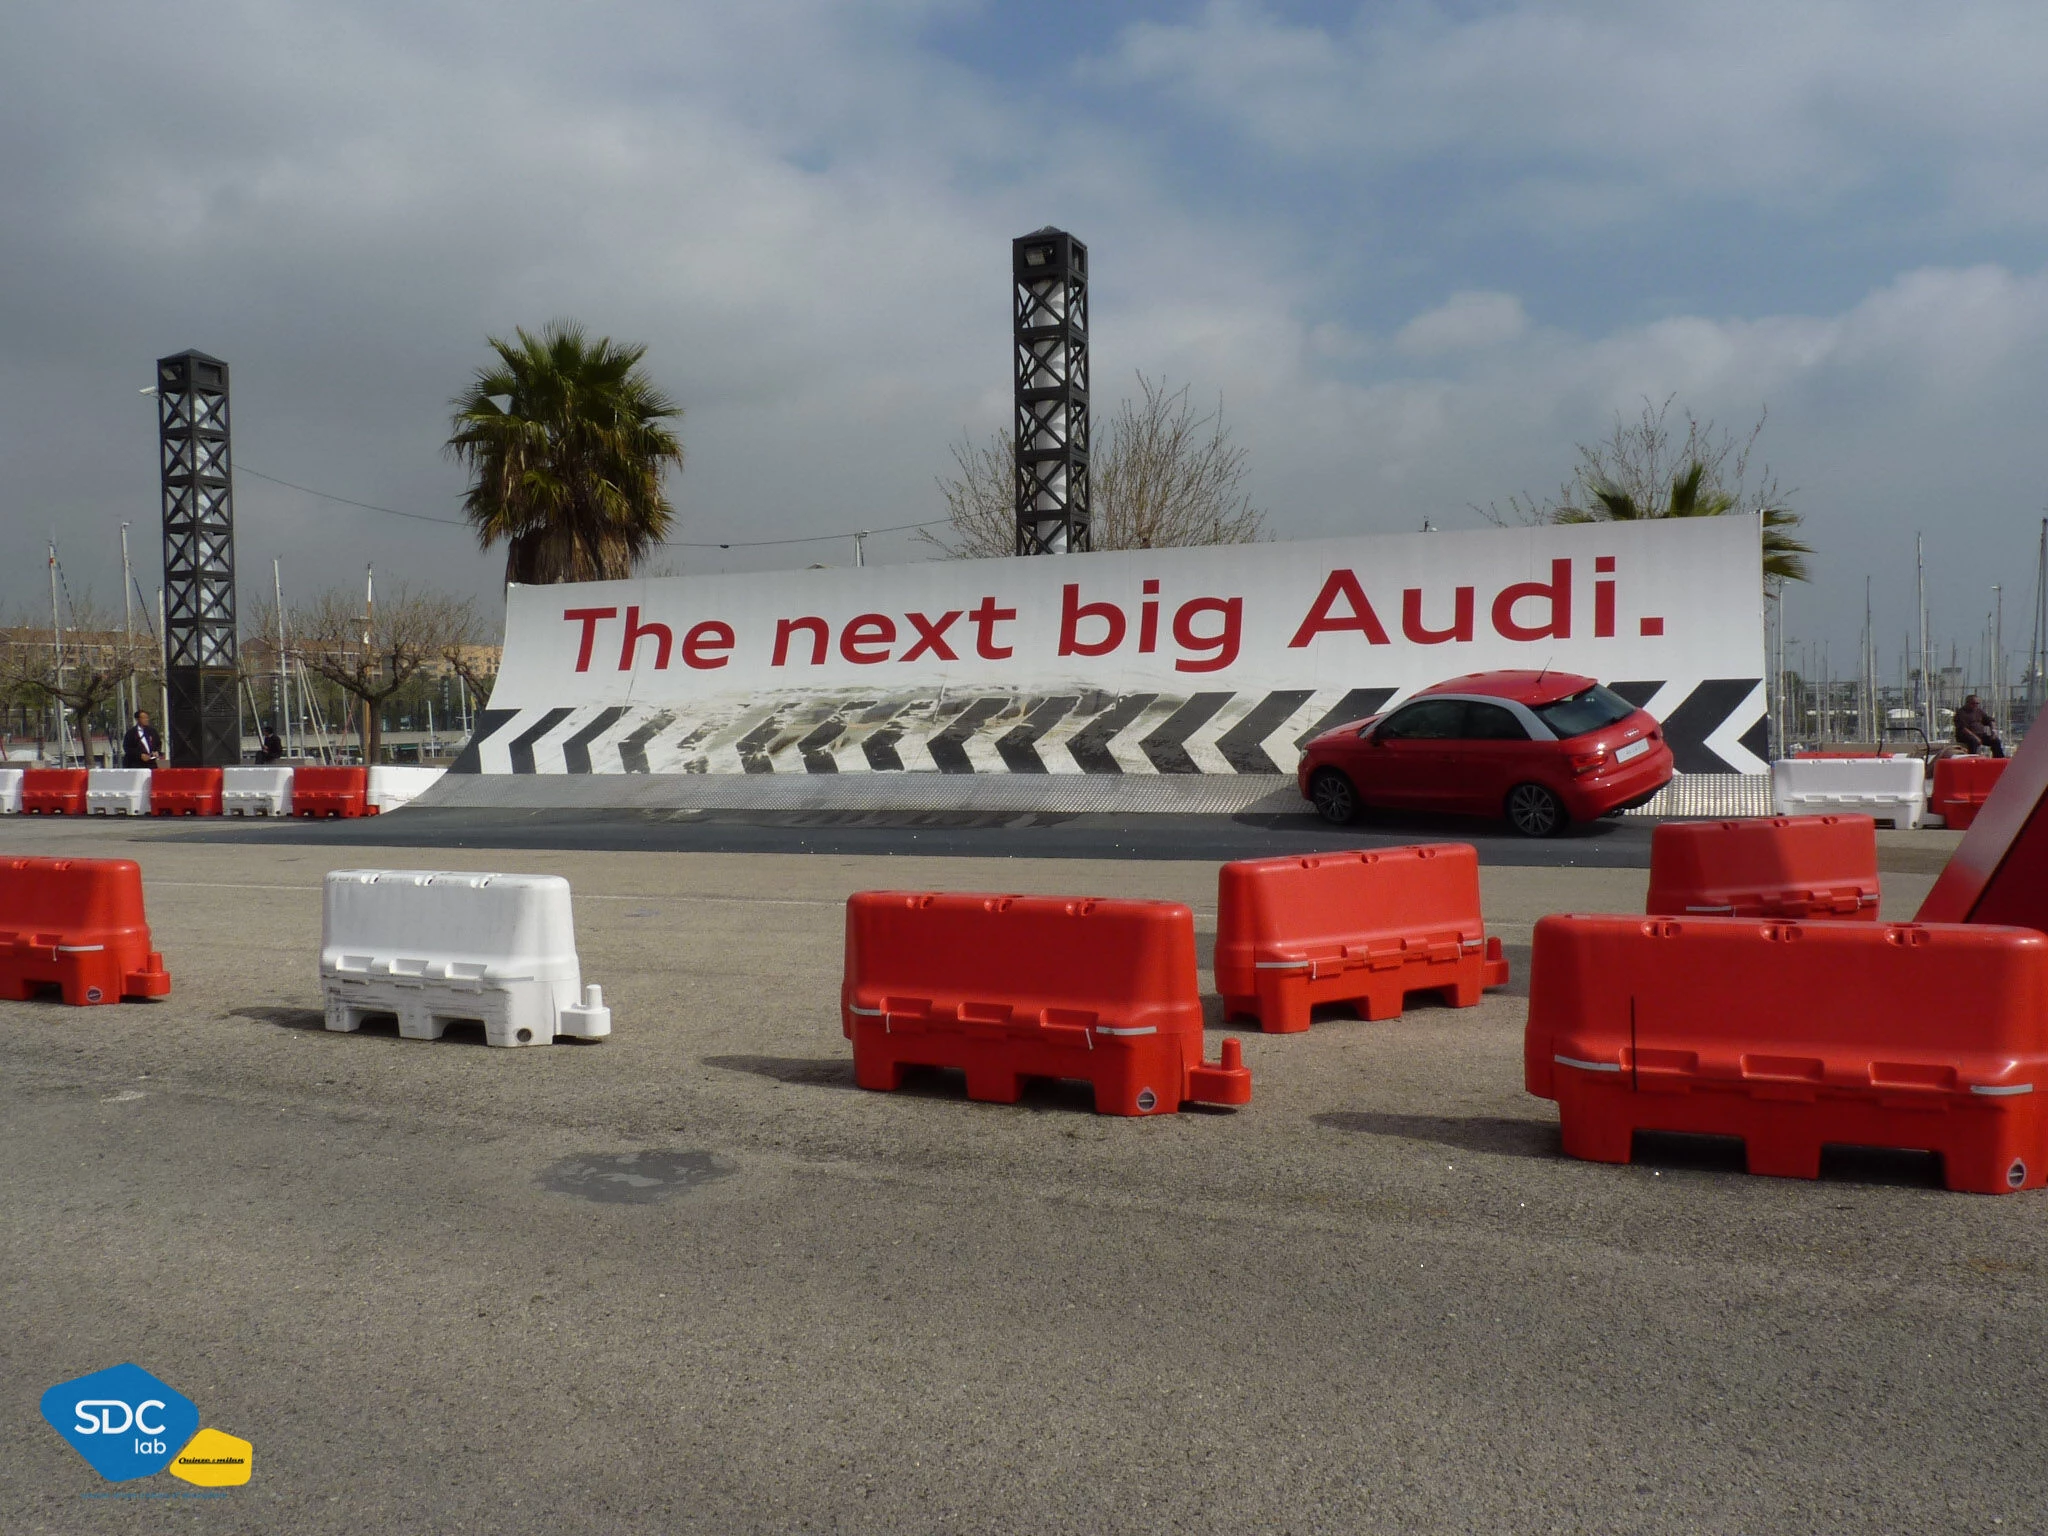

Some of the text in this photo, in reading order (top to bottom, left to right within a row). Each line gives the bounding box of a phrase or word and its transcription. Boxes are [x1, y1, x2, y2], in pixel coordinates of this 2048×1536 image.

[564, 556, 1665, 673] The next big Audi.
